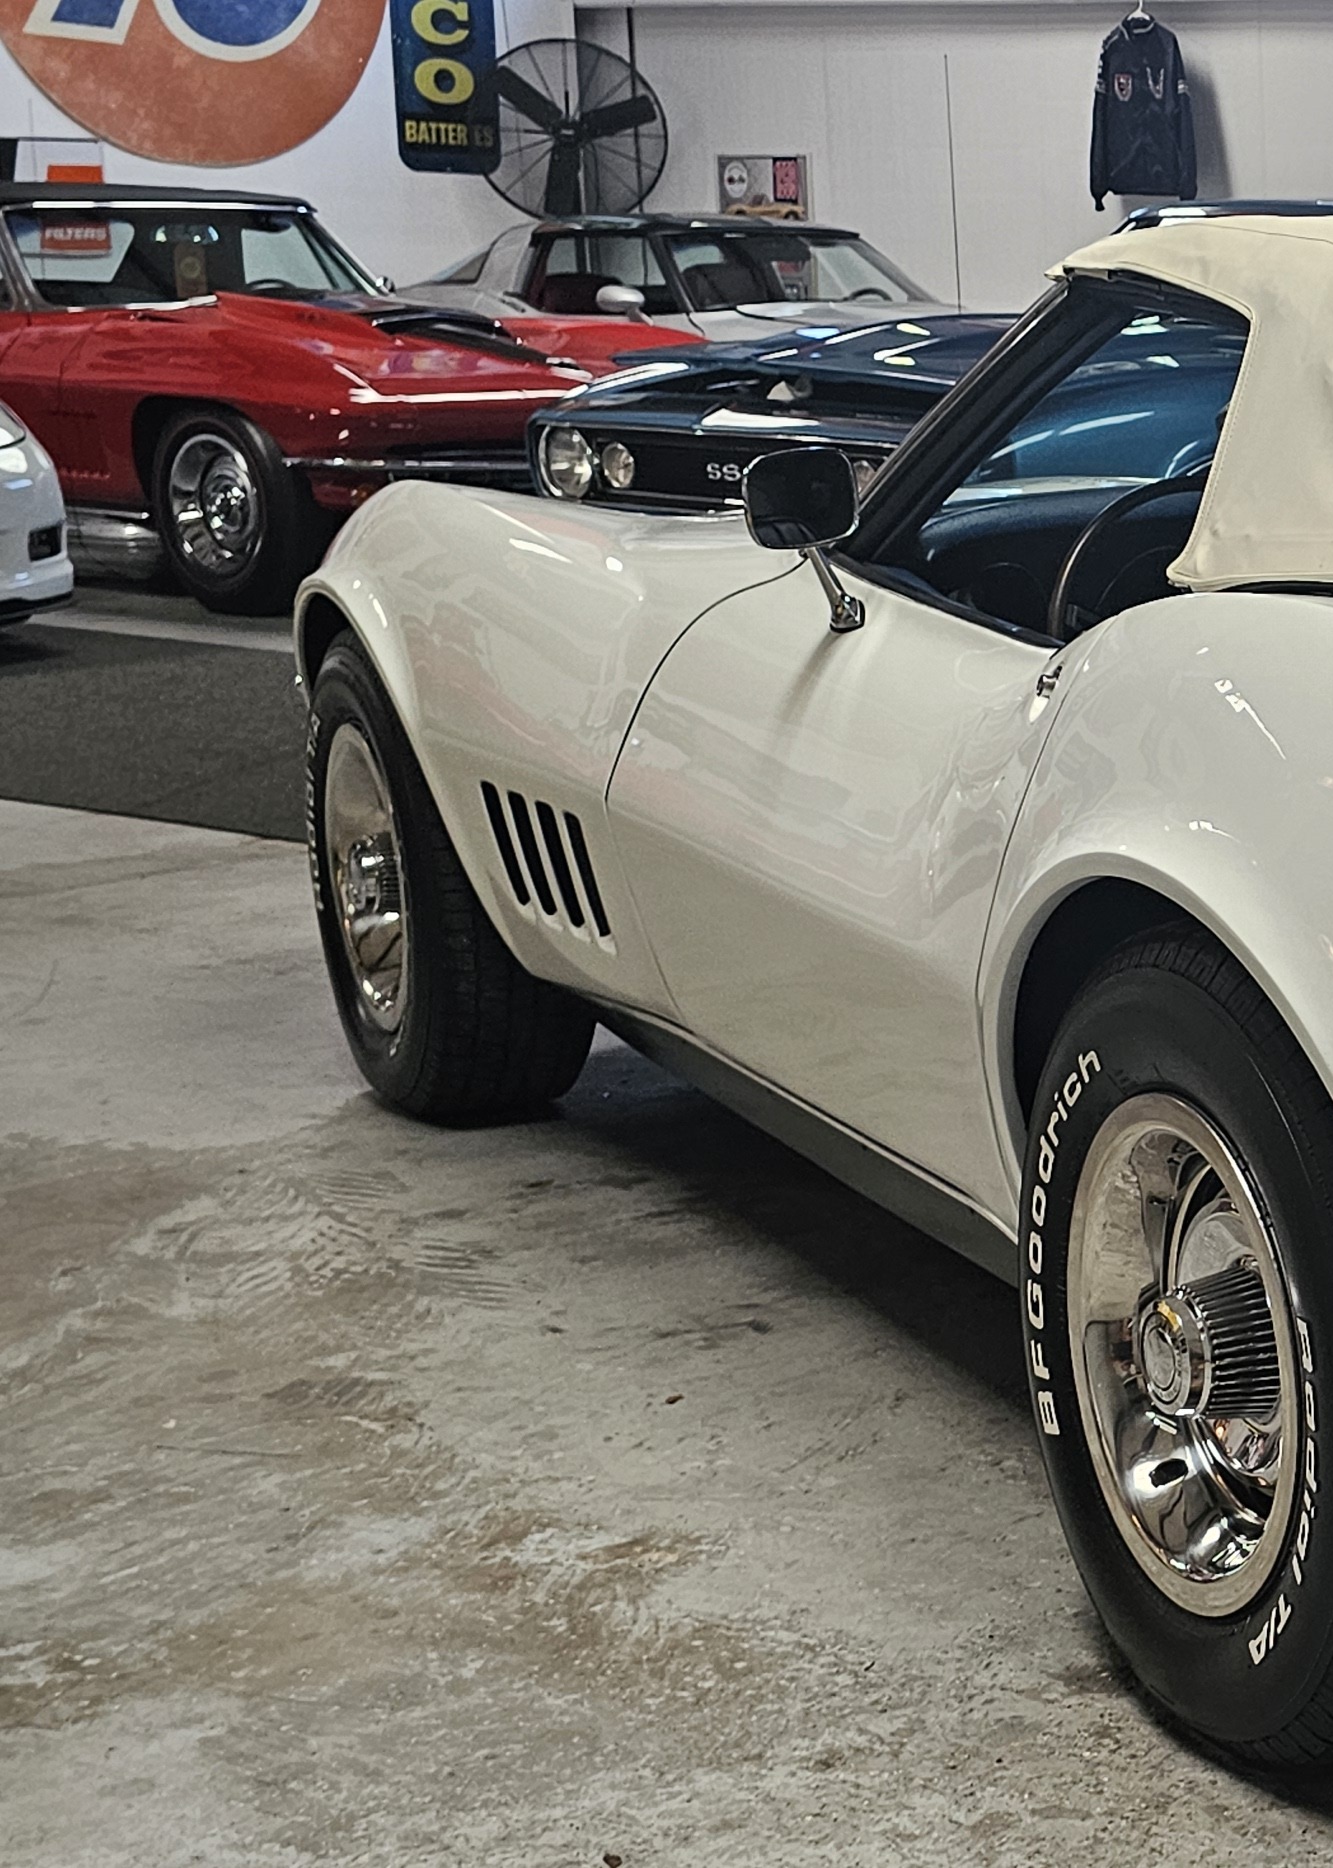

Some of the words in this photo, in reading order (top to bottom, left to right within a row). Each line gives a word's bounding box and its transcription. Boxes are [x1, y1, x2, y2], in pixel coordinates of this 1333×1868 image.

[405, 119, 494, 147] BATTERES
[44, 226, 108, 242] FILTERS
[706, 462, 742, 481] SS
